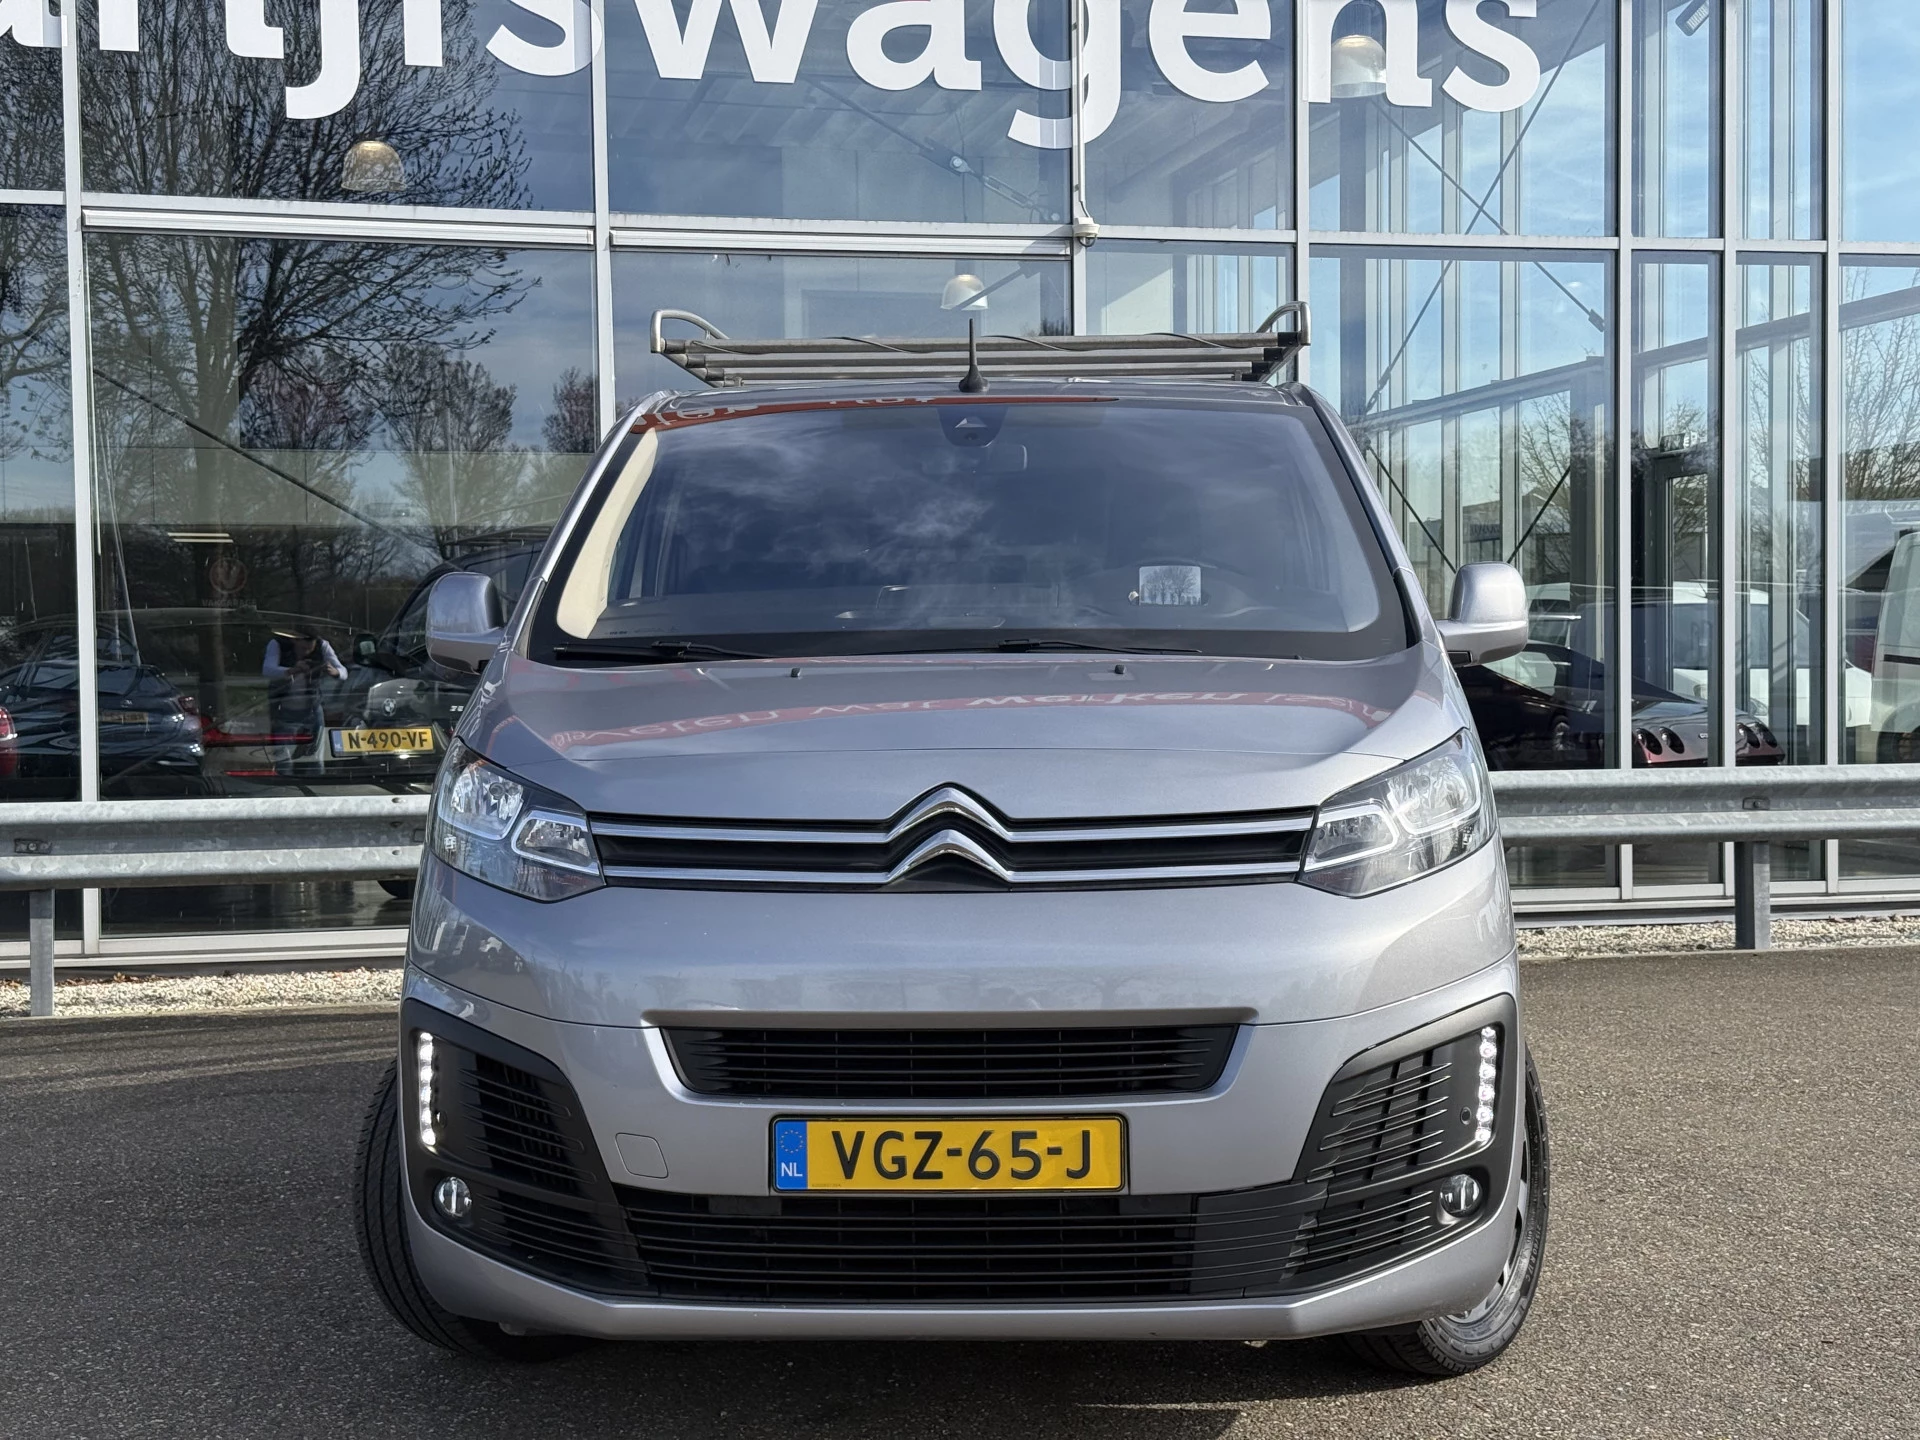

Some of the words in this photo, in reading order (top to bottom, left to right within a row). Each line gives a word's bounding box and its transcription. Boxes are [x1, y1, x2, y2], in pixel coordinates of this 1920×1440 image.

[348, 731, 428, 749] N-490-VF
[831, 1130, 1091, 1180] VGZ-65-J
[780, 1162, 803, 1178] NL
